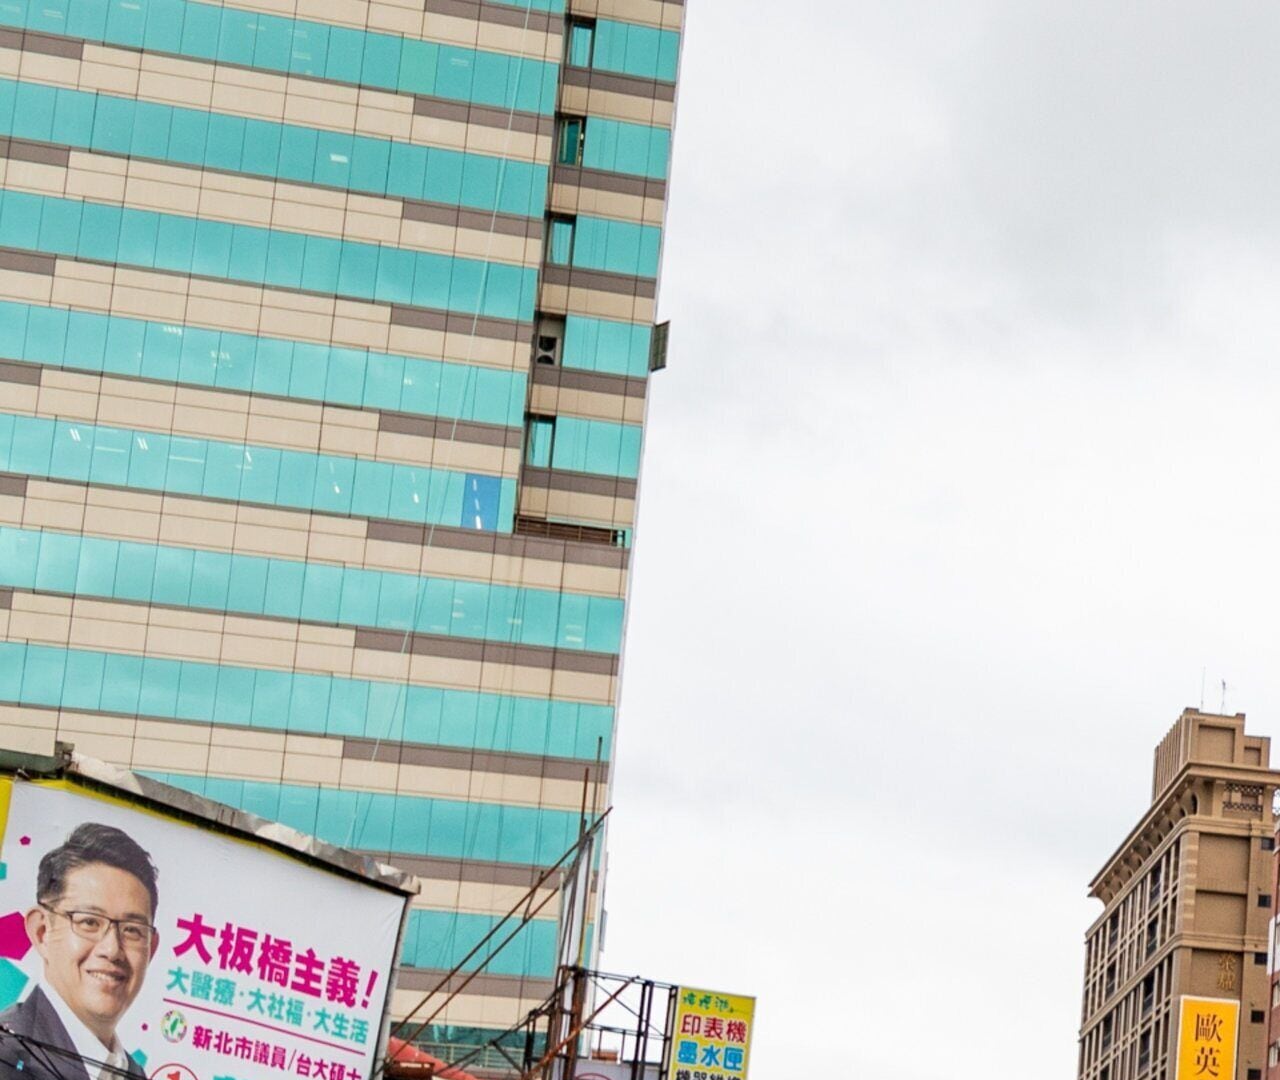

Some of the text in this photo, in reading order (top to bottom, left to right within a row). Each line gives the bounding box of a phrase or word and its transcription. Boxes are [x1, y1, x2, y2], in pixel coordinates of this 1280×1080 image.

[681, 1014, 747, 1043] 印表機
[678, 1041, 743, 1071] 墨水匣
